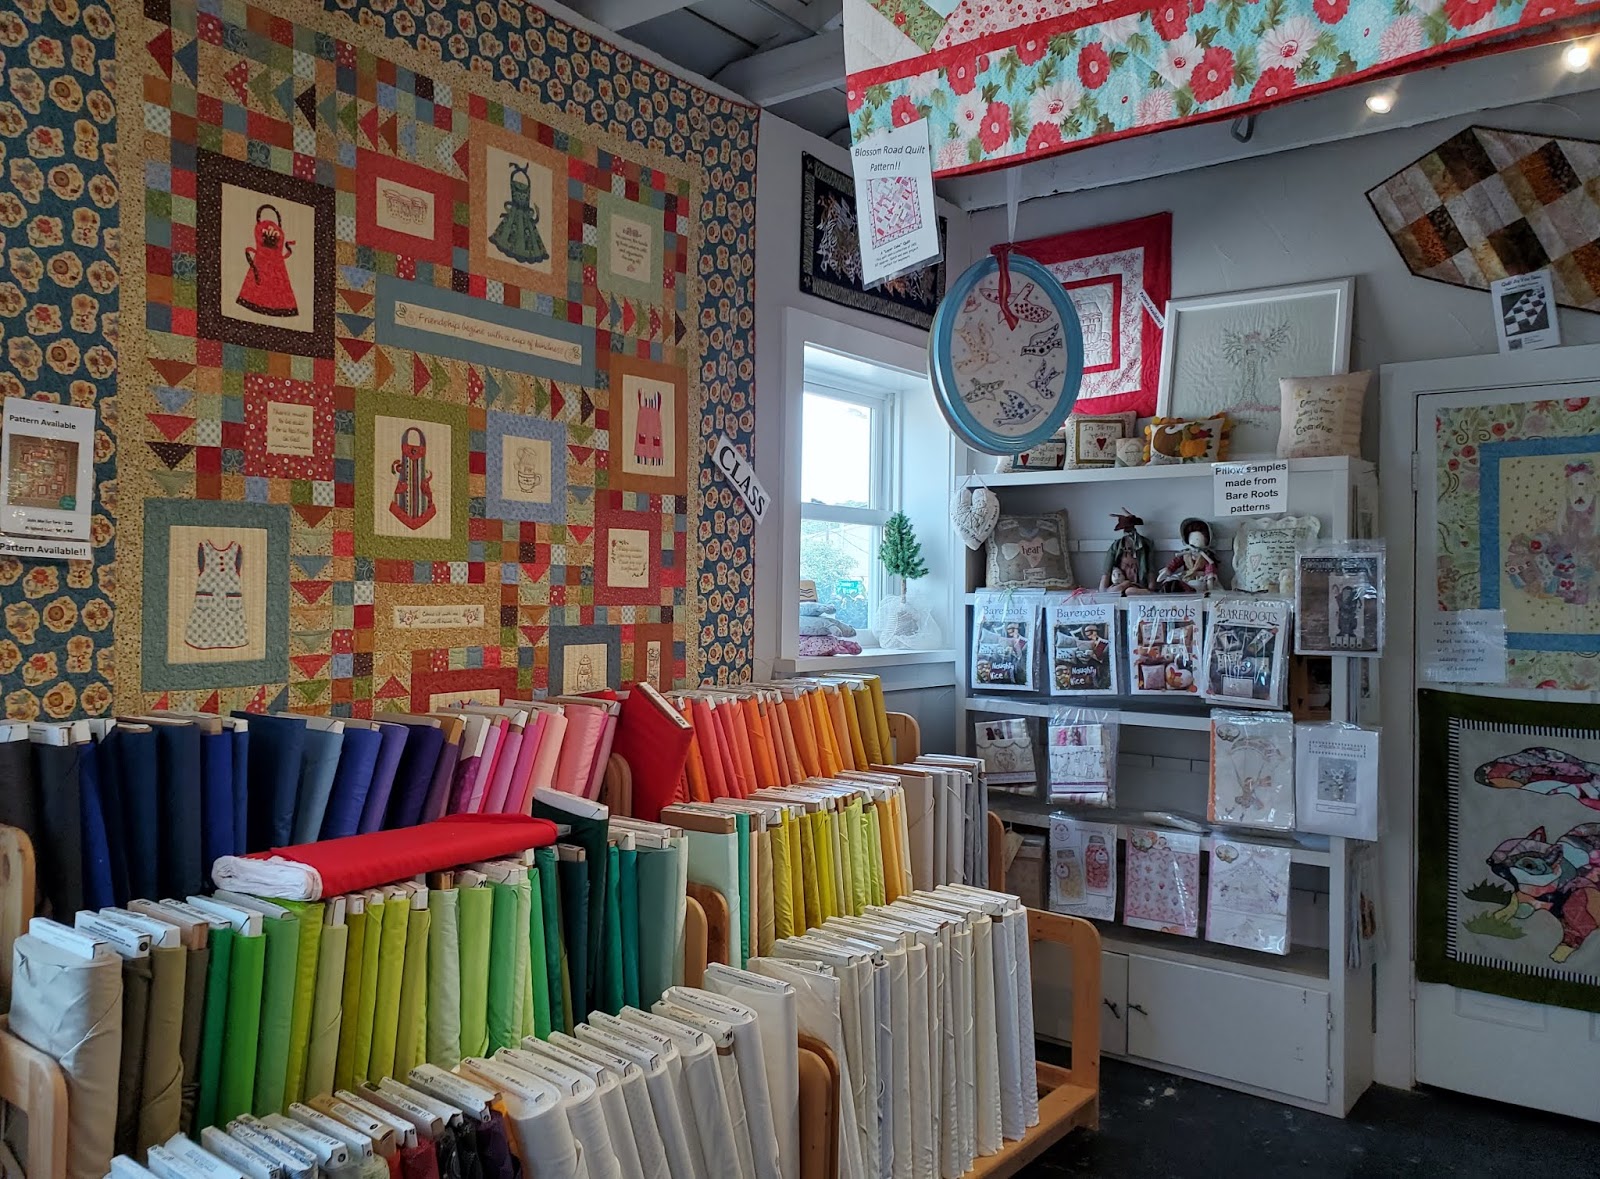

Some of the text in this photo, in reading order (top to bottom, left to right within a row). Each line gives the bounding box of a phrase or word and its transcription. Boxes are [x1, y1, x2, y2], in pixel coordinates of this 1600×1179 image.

[854, 145, 926, 157] Blossom Road Quilt
[869, 161, 901, 172] Pattern!!
[9, 414, 77, 430] Pattern Available
[1215, 463, 1287, 476] Pillow samples
[719, 445, 766, 516] CLASS
[1225, 476, 1277, 488] made from
[1225, 489, 1279, 501] Bare Roots
[1230, 503, 1271, 515] patterns
[0, 542, 87, 557] Pattern Available!!
[982, 605, 1028, 616] Bareoots
[1056, 606, 1106, 619] Bareroots
[1138, 604, 1196, 619] Bareroots
[1219, 607, 1278, 623] BAREROOTS
[1071, 665, 1097, 677] Naughty
